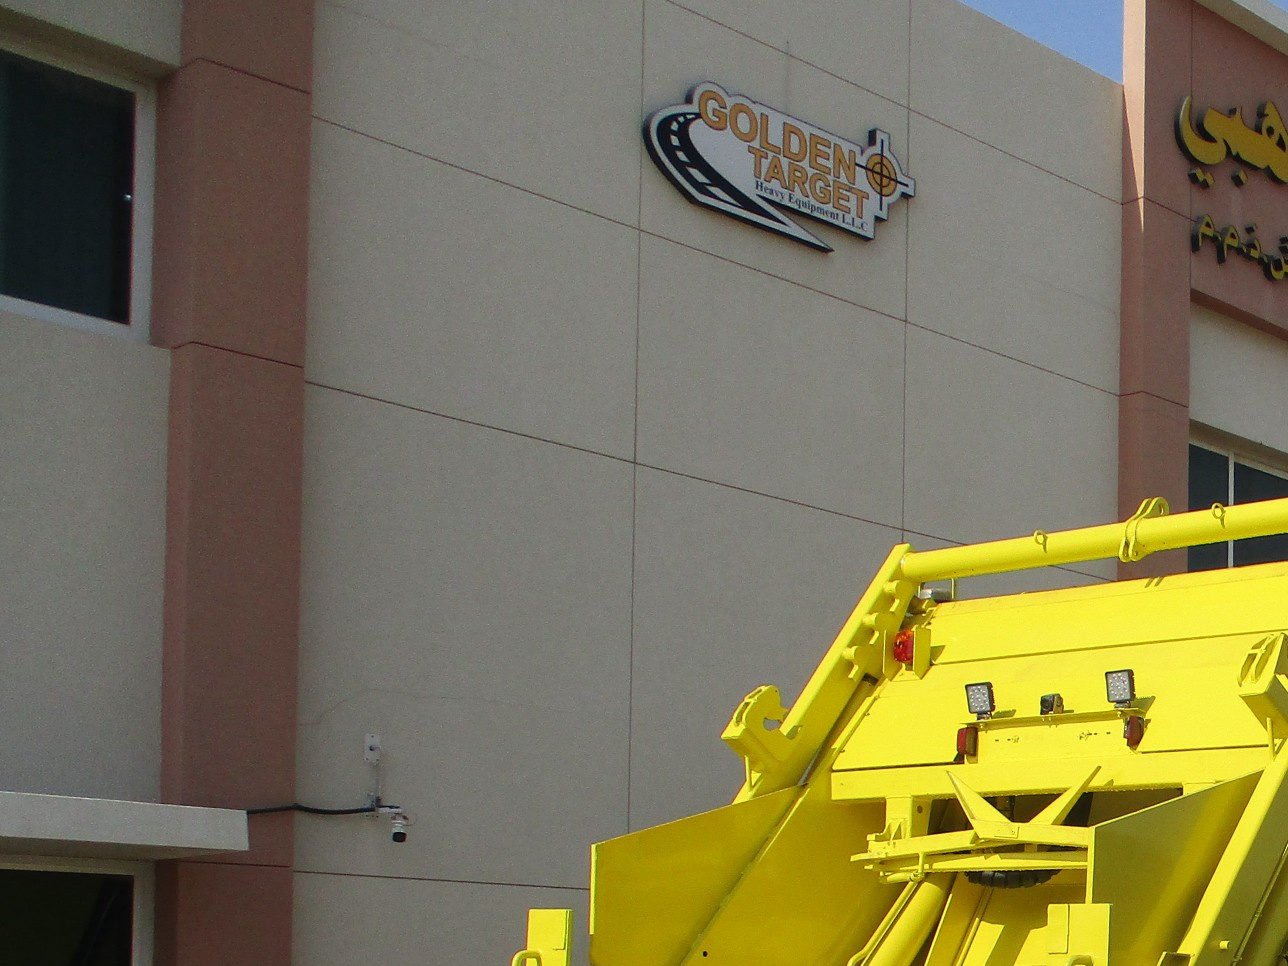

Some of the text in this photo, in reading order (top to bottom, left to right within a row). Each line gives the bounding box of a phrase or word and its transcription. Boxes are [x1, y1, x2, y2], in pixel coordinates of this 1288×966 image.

[699, 89, 856, 186] GOLDEN
[748, 145, 869, 219] TARGET
[755, 180, 786, 201] Heavy
[788, 193, 840, 220] Equipment
